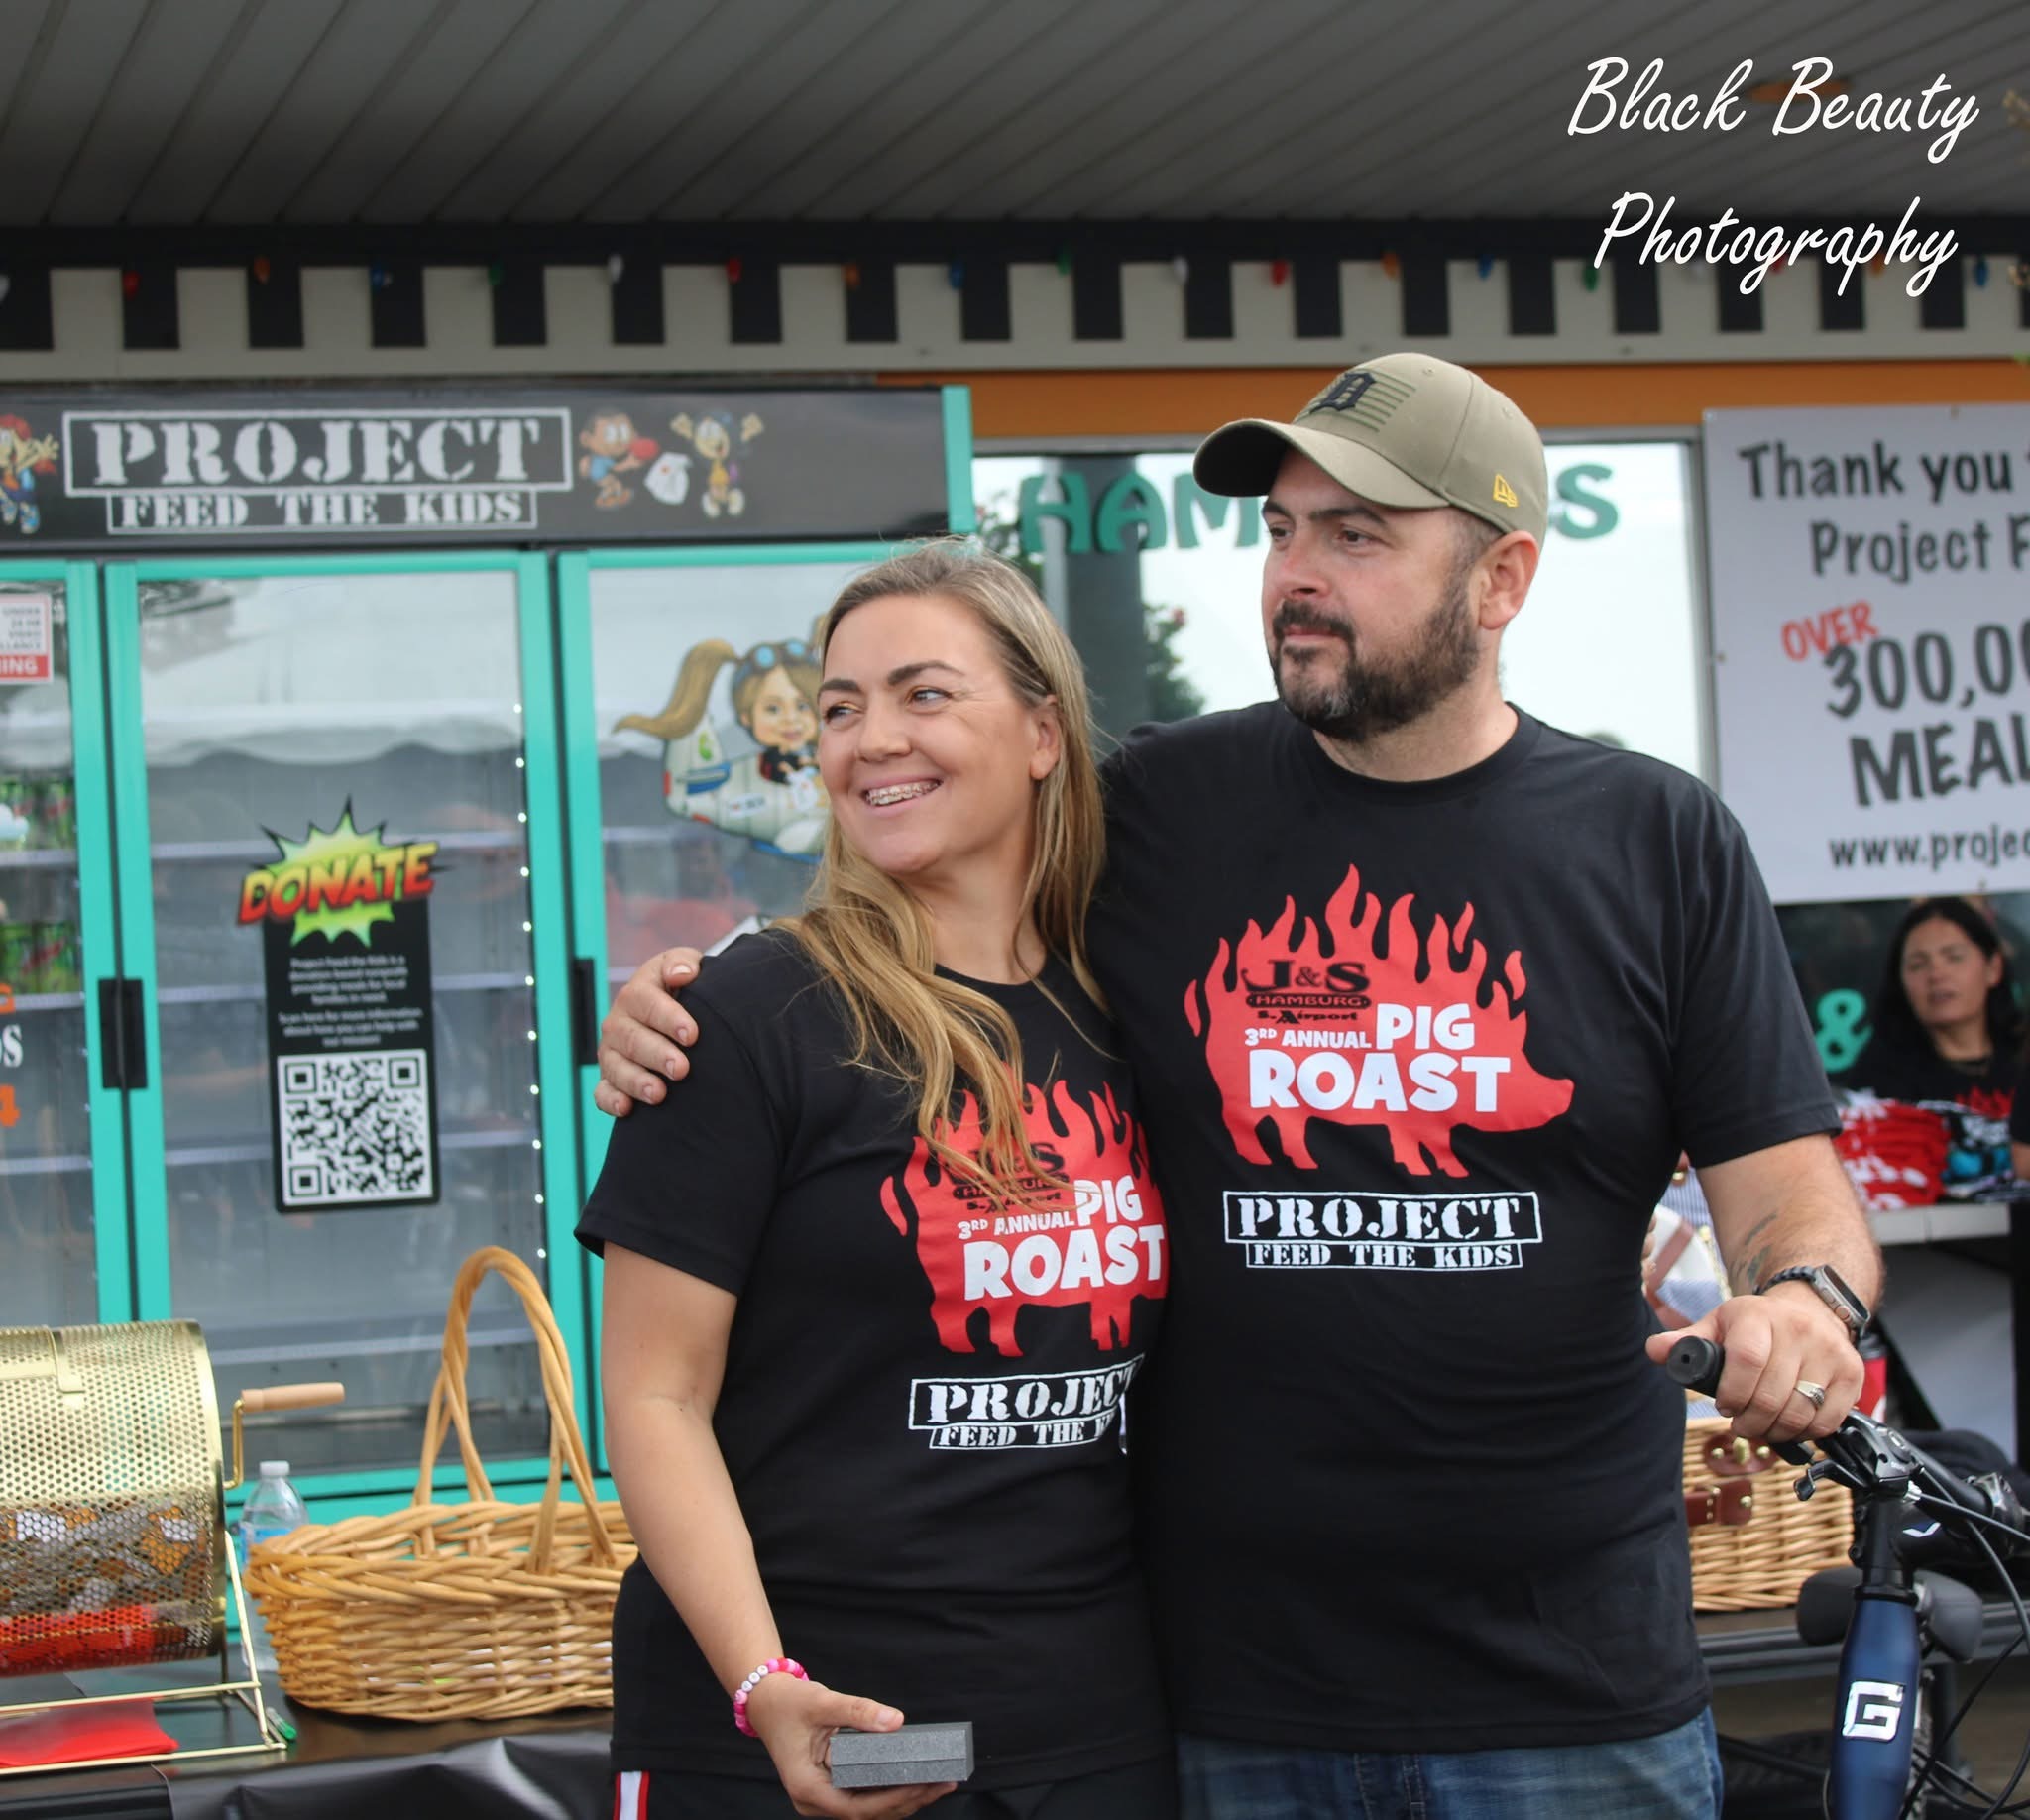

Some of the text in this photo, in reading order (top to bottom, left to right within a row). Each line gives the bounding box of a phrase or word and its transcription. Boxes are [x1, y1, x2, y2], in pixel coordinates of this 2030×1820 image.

[92, 419, 540, 485] PROJECT
[1738, 440, 2013, 504] Thank you
[121, 491, 523, 527] FEED THE KIDS
[1809, 518, 1992, 585] Project
[1782, 600, 1879, 661] OVER
[240, 842, 438, 925] DONATE
[1241, 959, 1370, 992] J&S
[1256, 995, 1362, 1007] HAMBURG
[1244, 1003, 1475, 1050] 3RD ANNUAL PIG
[1249, 1049, 1511, 1112] ROAST
[994, 1211, 1075, 1236] ANNUAL
[1074, 1176, 1144, 1227] PIG
[1238, 1197, 1519, 1239] PROJECT
[963, 1225, 1165, 1301] ROAST
[1254, 1244, 1513, 1268] FEED THE KIDS
[939, 1425, 1017, 1446] FEED
[1033, 1422, 1085, 1445] THE
[1842, 1681, 1903, 1741] G
